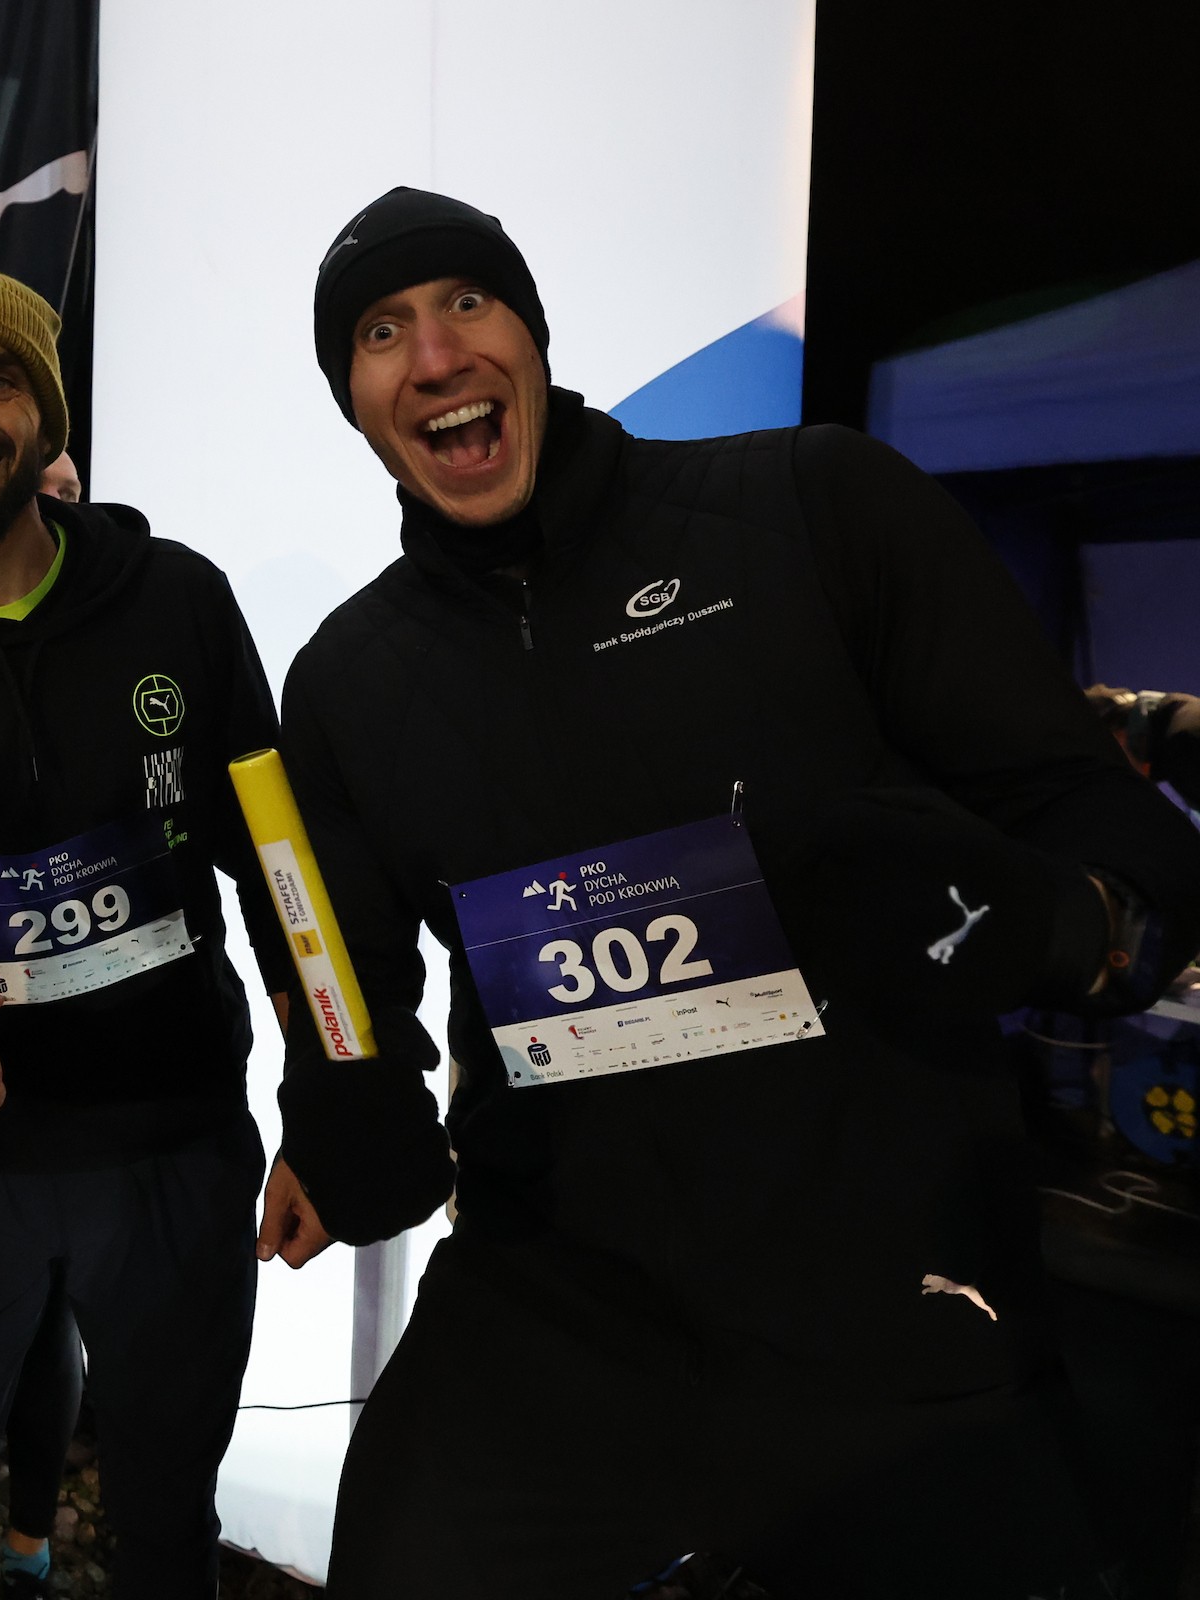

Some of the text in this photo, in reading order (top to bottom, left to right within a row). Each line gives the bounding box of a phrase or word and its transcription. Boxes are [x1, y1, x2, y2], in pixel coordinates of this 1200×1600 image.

[639, 592, 671, 606] SGB
[593, 597, 734, 652] Bank Spółdzielczy Duszniki
[49, 852, 69, 866] PKO
[51, 859, 84, 877] DYCHA
[53, 856, 118, 887] POD KROKWIĄ
[579, 862, 607, 878] PKO
[584, 872, 627, 893] DYCHA
[588, 875, 681, 908] POD KROKWIĄ
[273, 869, 300, 925] SZTAFETA
[8, 884, 131, 955] 299
[538, 913, 714, 1003] 302
[314, 987, 353, 1058] polanik
[676, 1006, 698, 1017] InPost
[530, 1070, 564, 1081] Bank Polski
